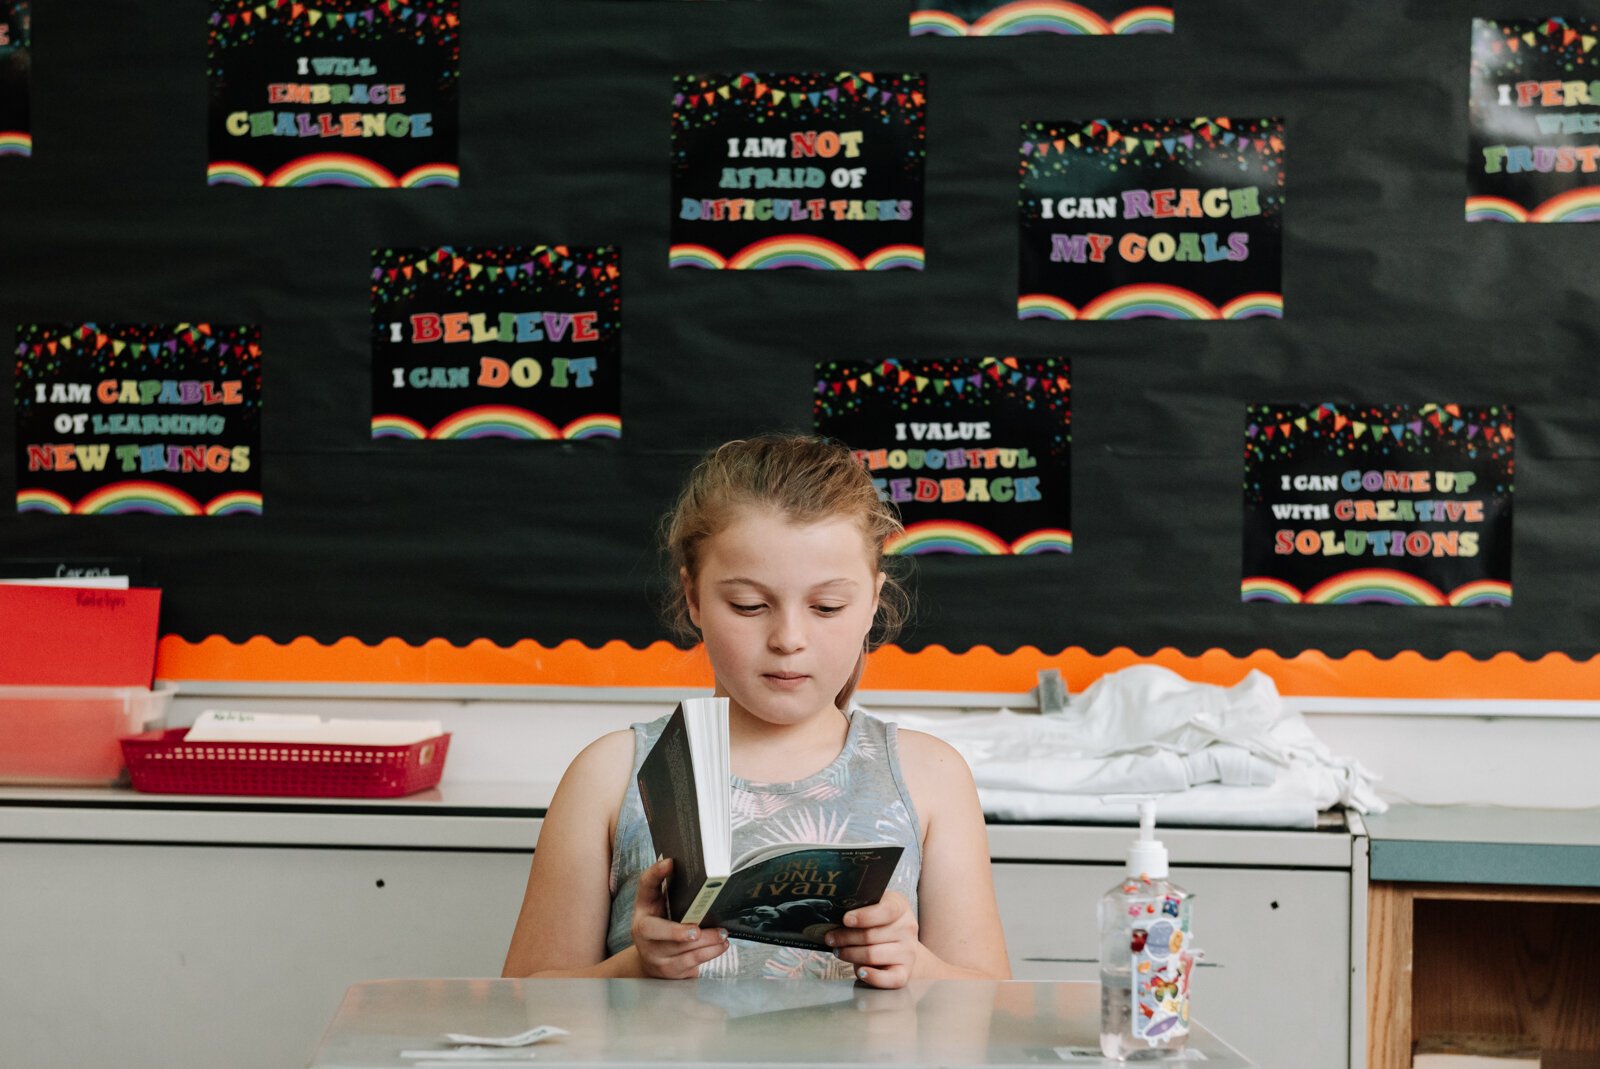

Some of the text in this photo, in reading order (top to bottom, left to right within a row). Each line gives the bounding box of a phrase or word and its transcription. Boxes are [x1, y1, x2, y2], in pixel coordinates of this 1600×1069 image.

[297, 57, 377, 76] I WILL
[268, 83, 406, 104] EMBRACE
[1498, 84, 1511, 106] I
[226, 112, 433, 137] CHALLENGE
[727, 131, 863, 158] I AM NOT
[719, 167, 867, 188] AFRAID OF
[680, 198, 913, 221] DIFFICULT TASKS
[1041, 186, 1261, 219] I CAN REACH
[1050, 232, 1249, 262] MY GOALS
[390, 311, 599, 343] I BELIEVE
[392, 356, 597, 388] I CAN DO IT
[35, 379, 243, 405] I AM CAPABLE
[54, 413, 226, 434] OF LEARNING
[895, 421, 991, 440] I VALUE
[27, 444, 250, 473] NEW THINGS
[1281, 470, 1477, 493] I CAN COME UP
[1272, 500, 1484, 522] WITH CREATIVE
[1275, 529, 1479, 557] SOLUTIONS
[773, 869, 842, 883] ONLY
[751, 881, 837, 898] Ivan
